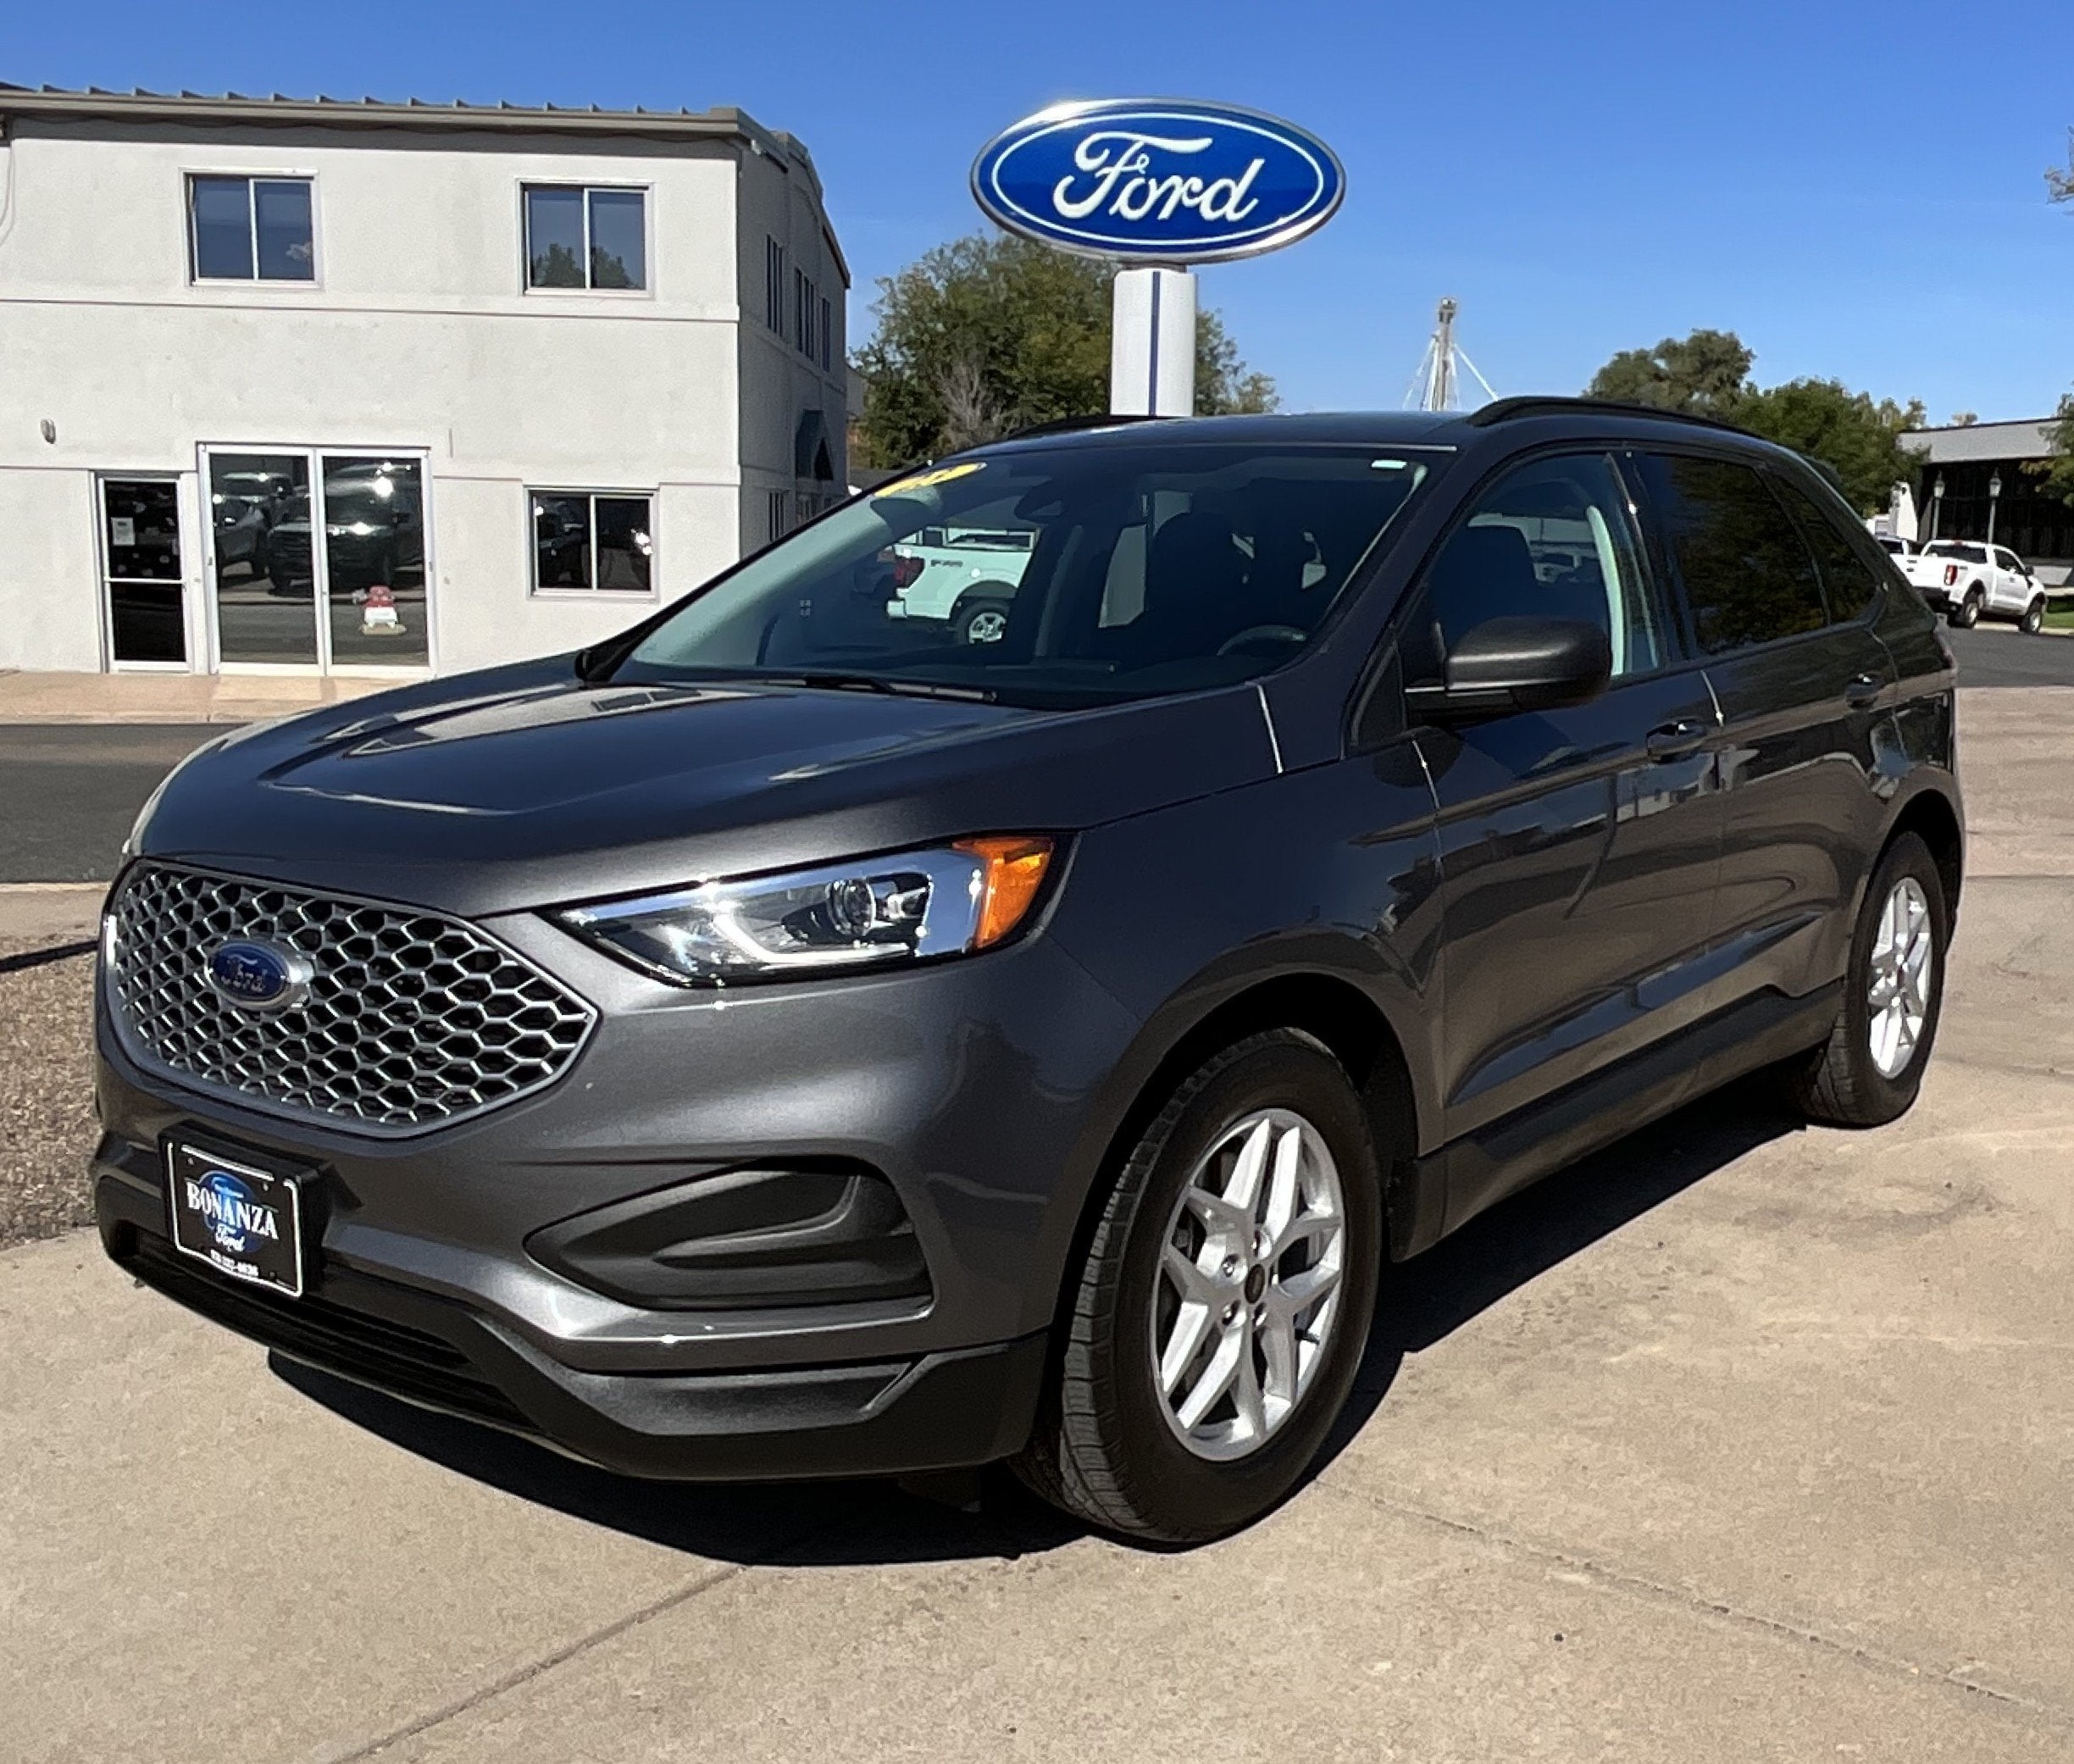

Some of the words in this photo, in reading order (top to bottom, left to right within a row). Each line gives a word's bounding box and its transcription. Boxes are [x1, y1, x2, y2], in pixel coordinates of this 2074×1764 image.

[1053, 130, 1265, 222] Ford
[186, 1180, 279, 1240] BONANZA
[215, 1223, 246, 1252] Ford
